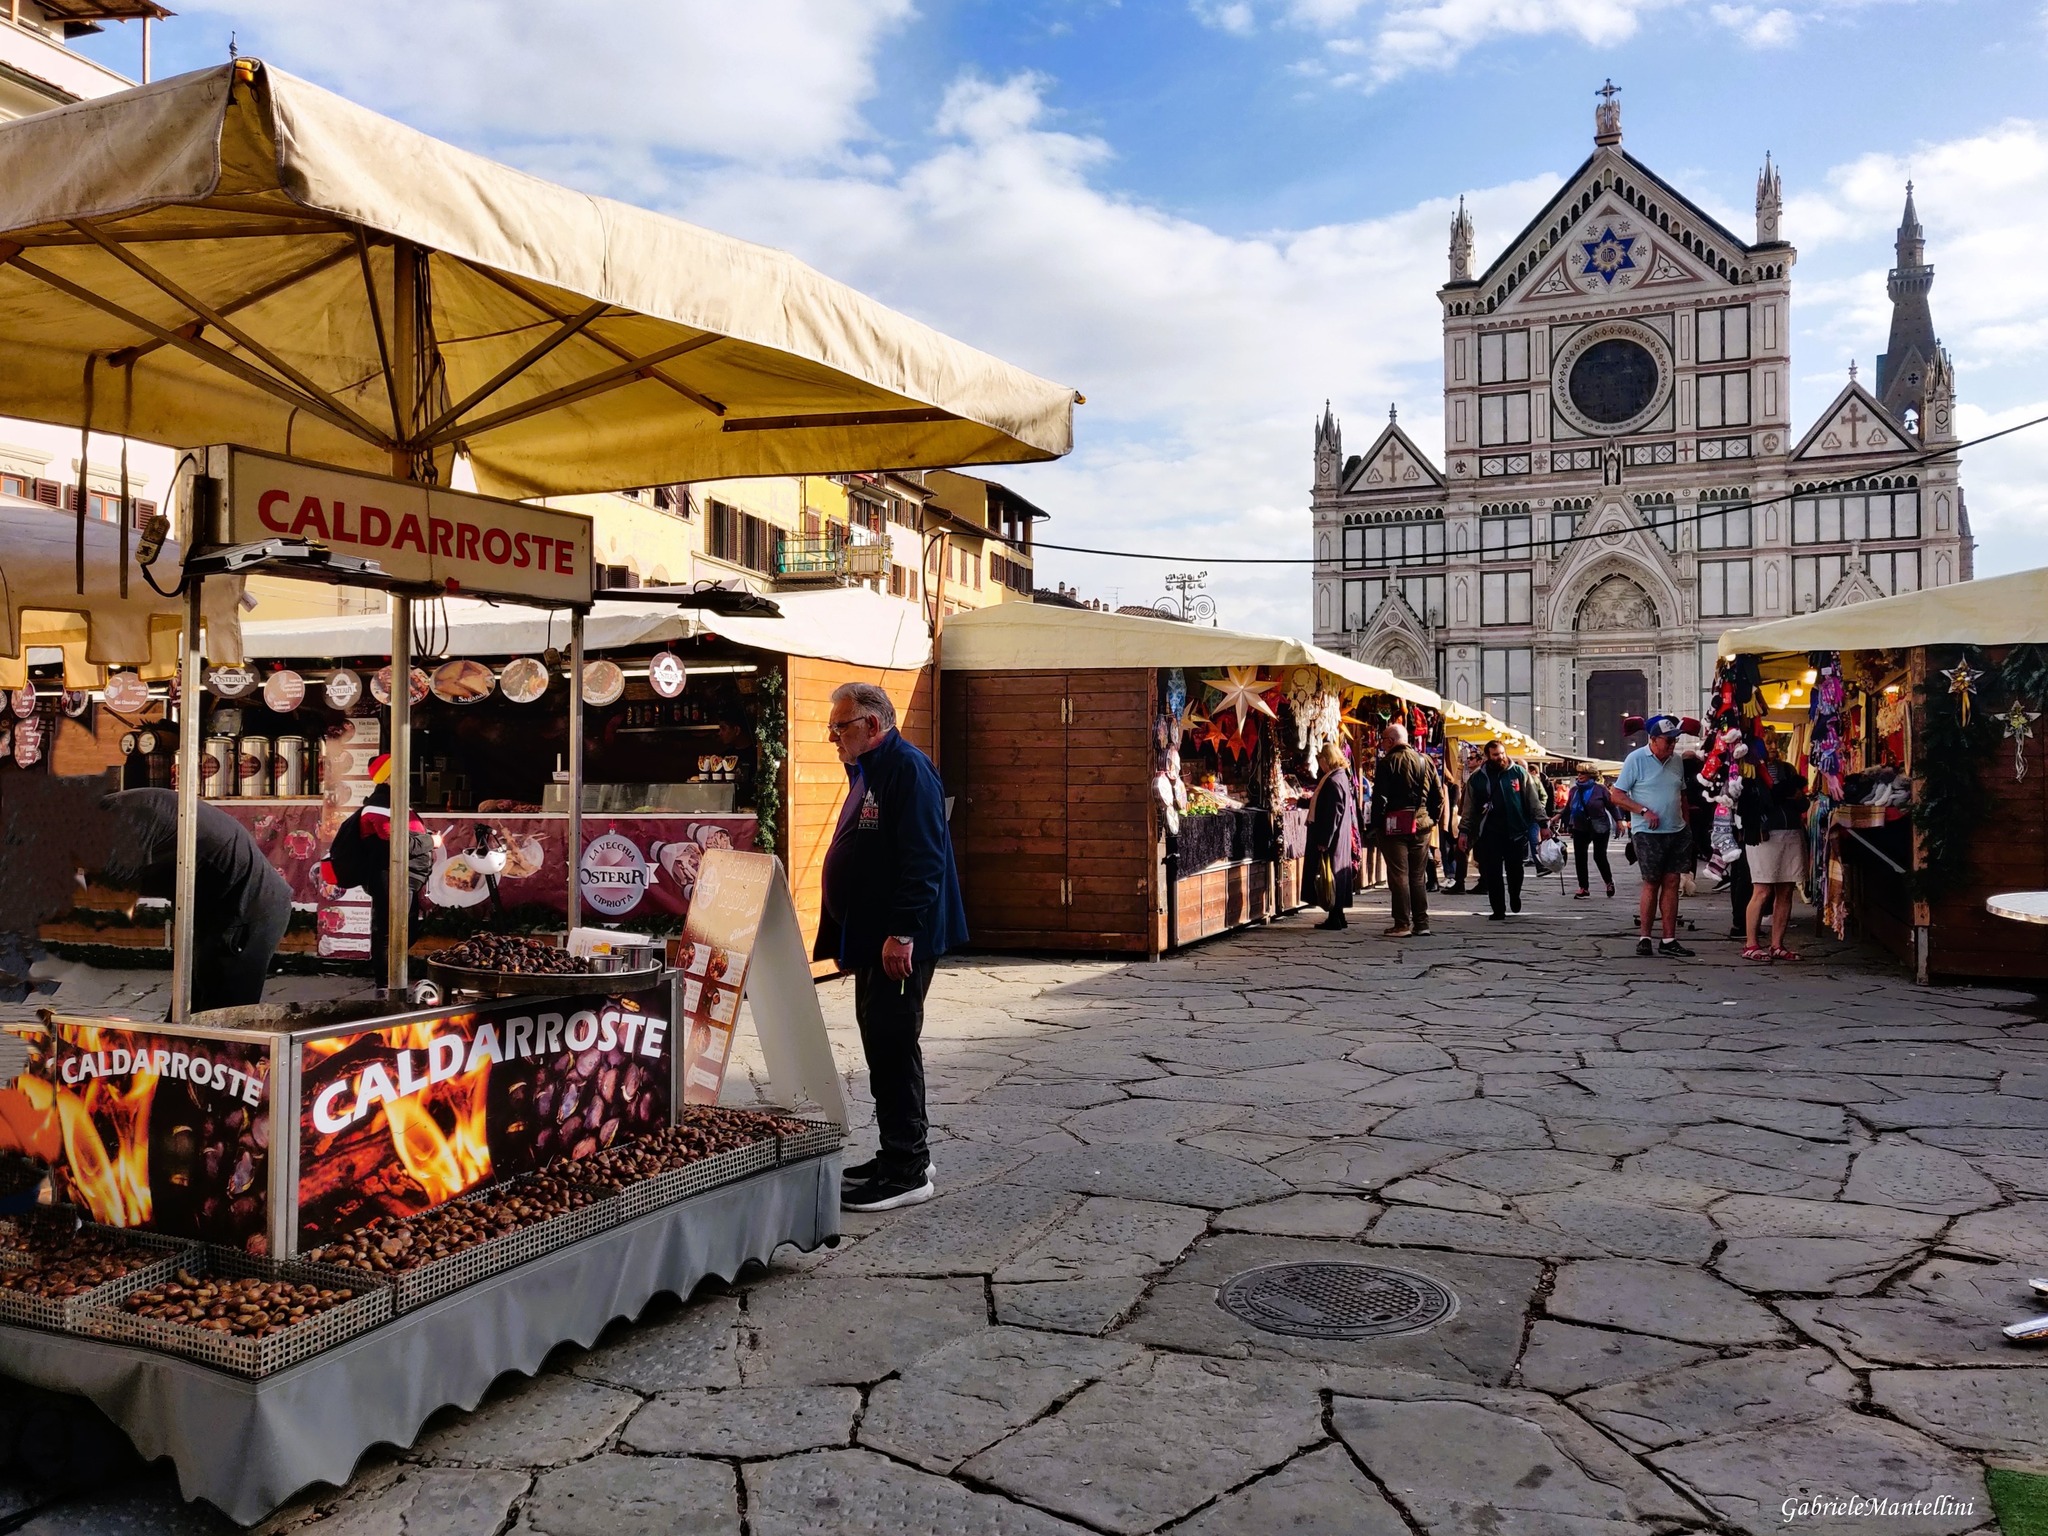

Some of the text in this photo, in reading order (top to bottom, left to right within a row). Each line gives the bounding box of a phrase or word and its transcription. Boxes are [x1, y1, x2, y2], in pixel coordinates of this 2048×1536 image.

[258, 489, 574, 575] CALDARROSTE
[588, 841, 636, 863] LA VECCHIA
[581, 868, 647, 887] OSTERIA
[593, 893, 634, 908] CIPRIOTA
[61, 1048, 264, 1108] CALDARROSTE
[312, 1010, 668, 1135] CALDARROSTE
